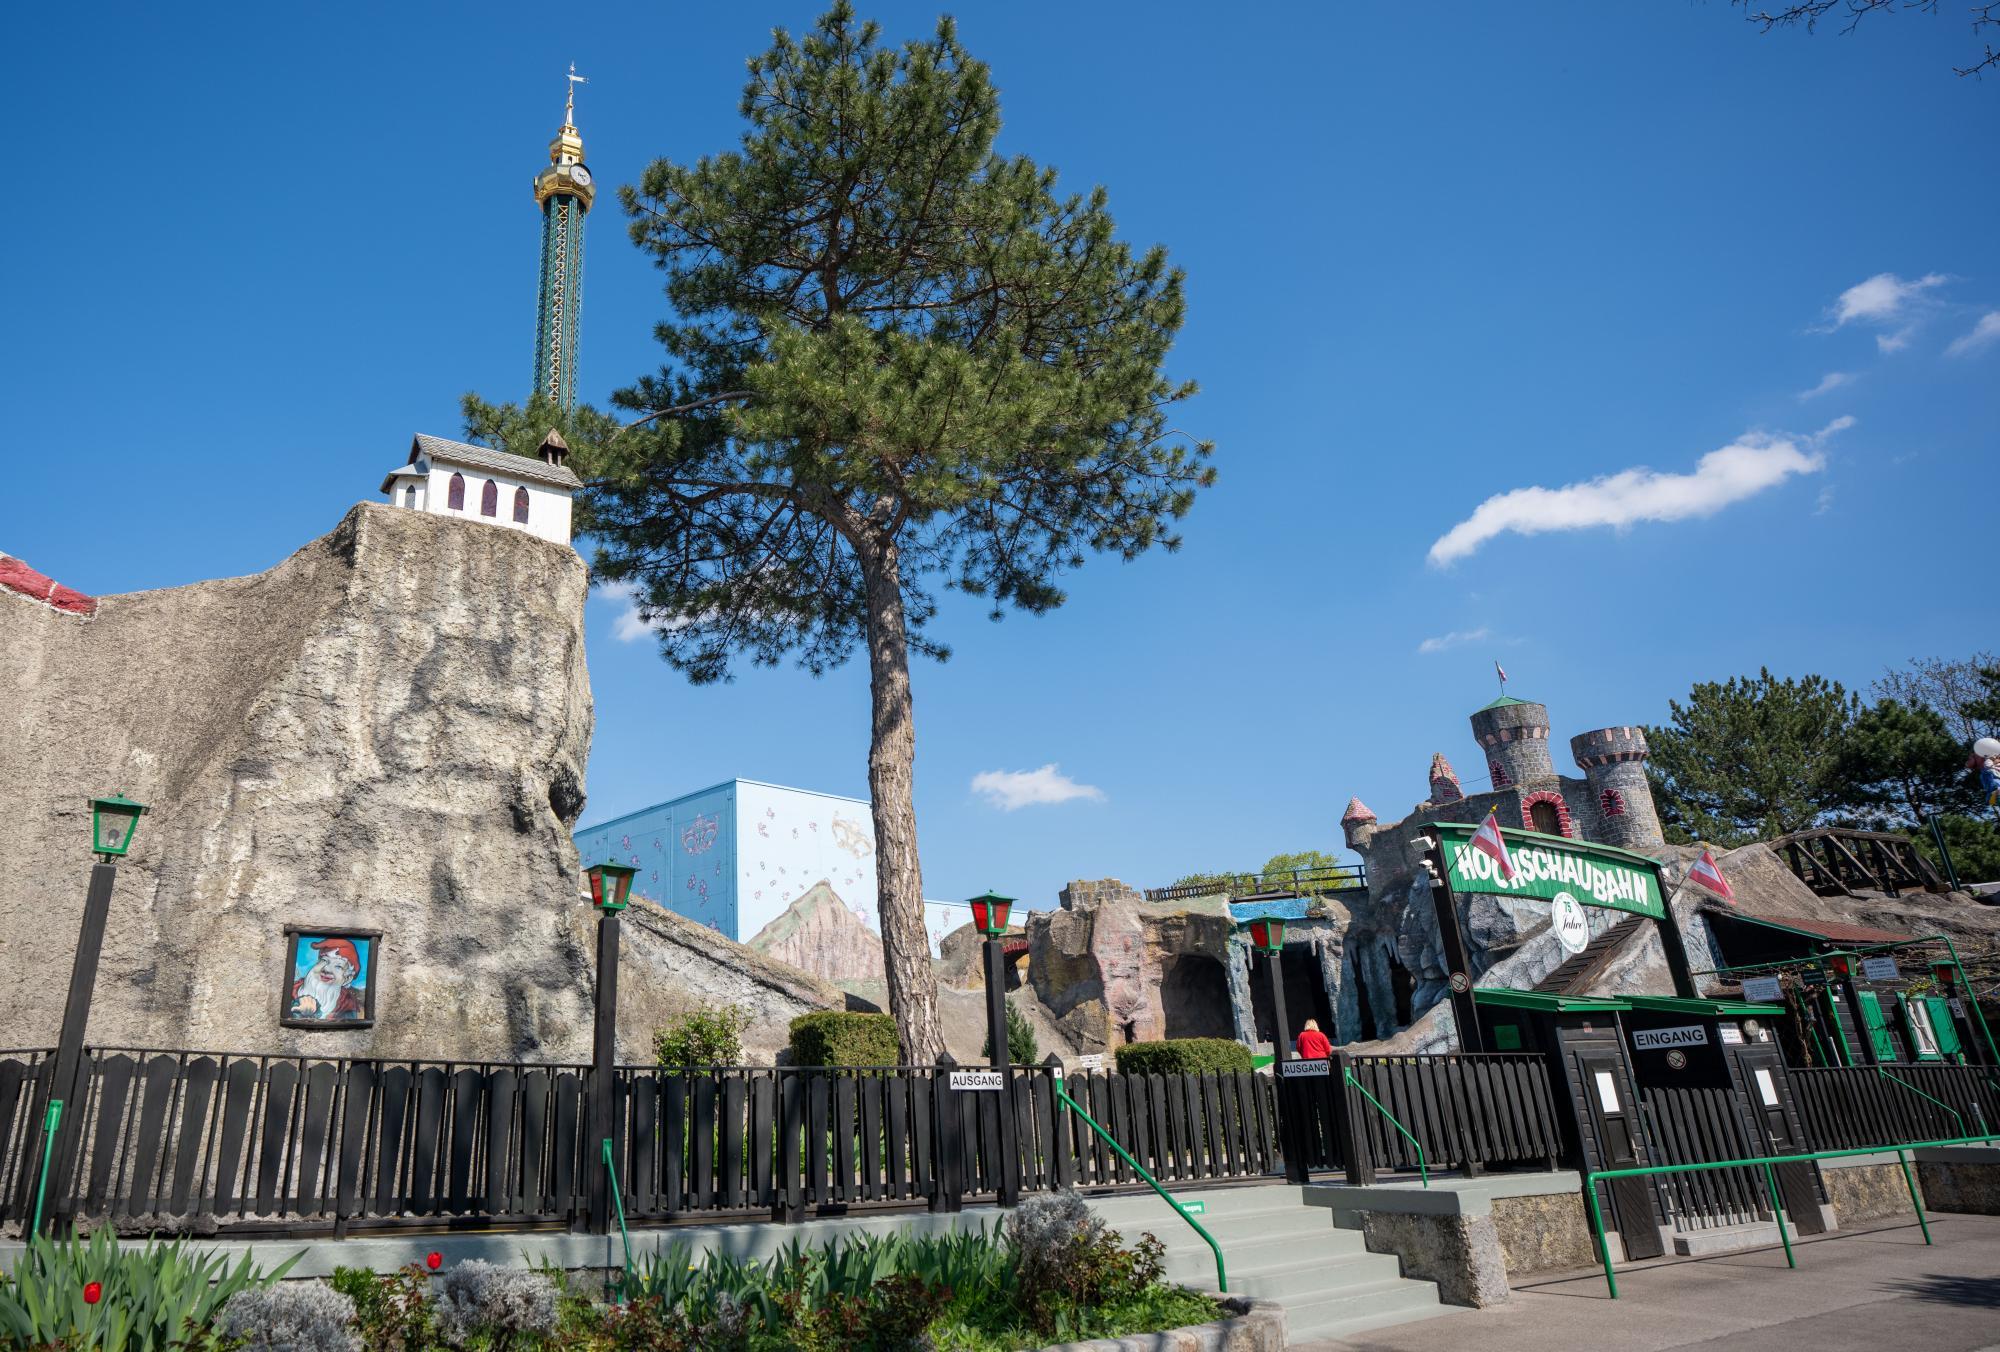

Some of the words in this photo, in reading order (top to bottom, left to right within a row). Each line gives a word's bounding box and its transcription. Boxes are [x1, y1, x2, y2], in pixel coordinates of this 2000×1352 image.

[1562, 914, 1583, 931] Jahre
[1636, 1029, 1704, 1046] EINGANG
[1284, 1063, 1328, 1074] AUSGANG
[952, 1075, 1002, 1086] AUSGANG
